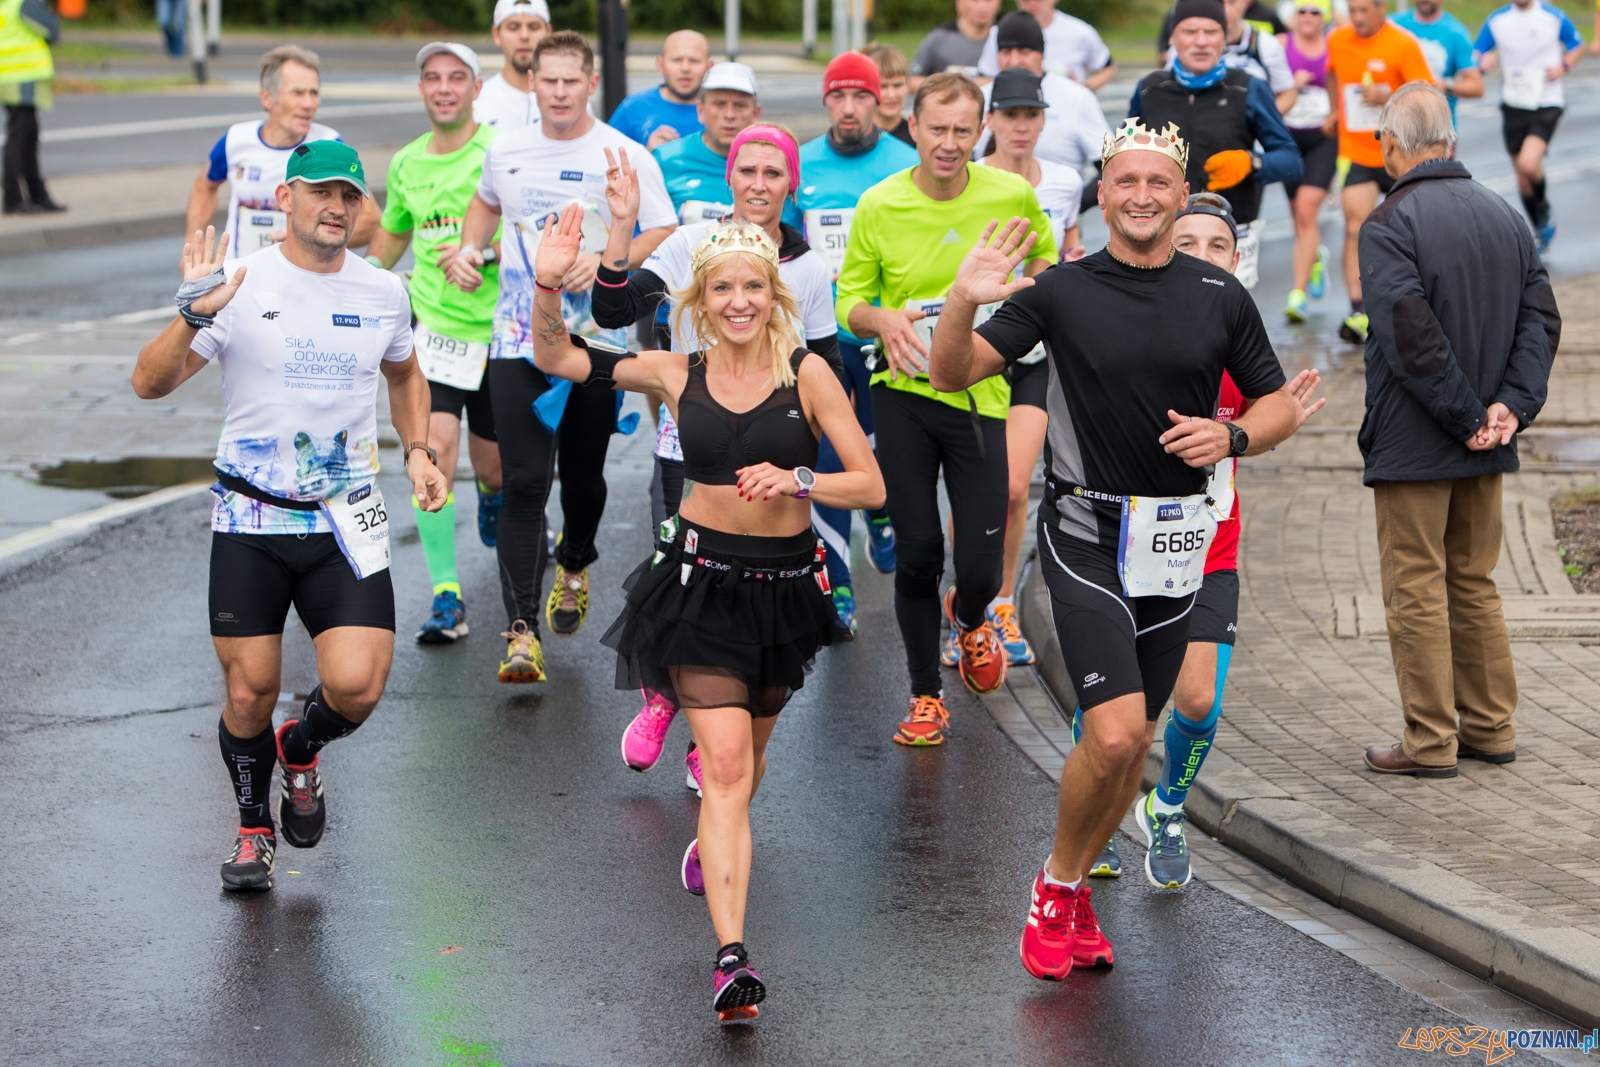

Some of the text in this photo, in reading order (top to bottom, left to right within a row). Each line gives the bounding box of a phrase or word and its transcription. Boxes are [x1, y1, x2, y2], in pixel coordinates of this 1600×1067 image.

[1202, 277, 1225, 287] Reebok
[262, 311, 280, 320] 4F
[335, 316, 359, 325] 17.PKO
[285, 337, 316, 349] SIŁA
[426, 333, 469, 357] 1993
[294, 350, 358, 364] ODWAGA
[284, 362, 358, 376] SZYBKOŚĆ
[290, 381, 336, 391] października
[337, 383, 354, 391] 2016
[1217, 407, 1235, 416] CZKA
[1084, 489, 1122, 503] ICEBUG
[354, 503, 387, 532] 326
[1160, 508, 1182, 517] 17.PKO
[1152, 529, 1205, 554] 6685
